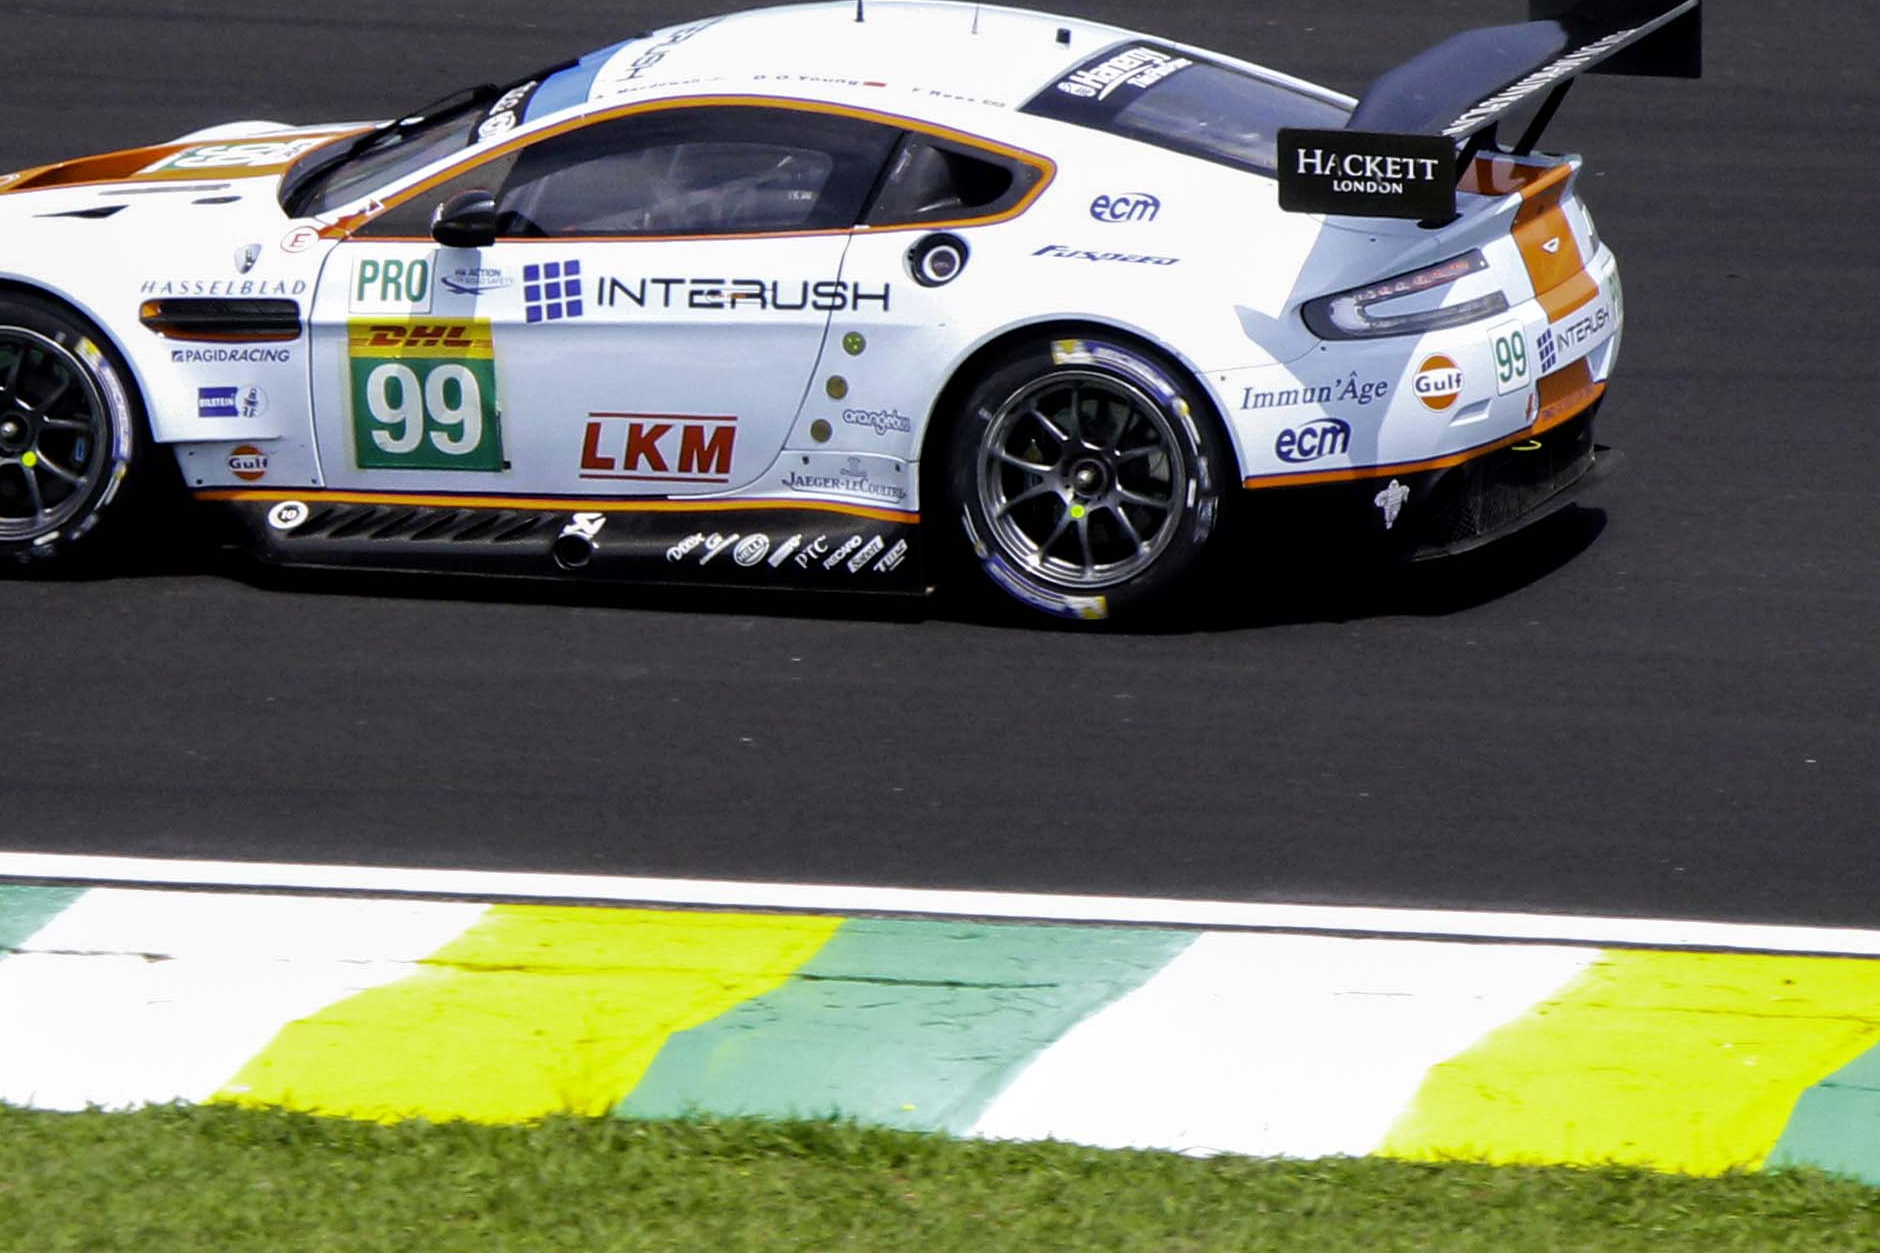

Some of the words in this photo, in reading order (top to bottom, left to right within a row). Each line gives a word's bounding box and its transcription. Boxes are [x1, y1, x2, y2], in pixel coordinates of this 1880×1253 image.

[1297, 148, 1439, 181] HACKETT
[1333, 179, 1404, 195] LONDON
[1090, 193, 1161, 223] ecm
[140, 279, 307, 296] HASSELBLAD
[357, 258, 429, 303] PRO
[597, 276, 890, 312] INTERUSH
[369, 325, 474, 347] DHL
[1495, 330, 1527, 383] 99
[1415, 372, 1463, 394] Gulf
[366, 362, 483, 455] 99
[580, 421, 738, 475] LKM
[1275, 418, 1351, 463] ecm
[228, 456, 269, 470] Gulf
